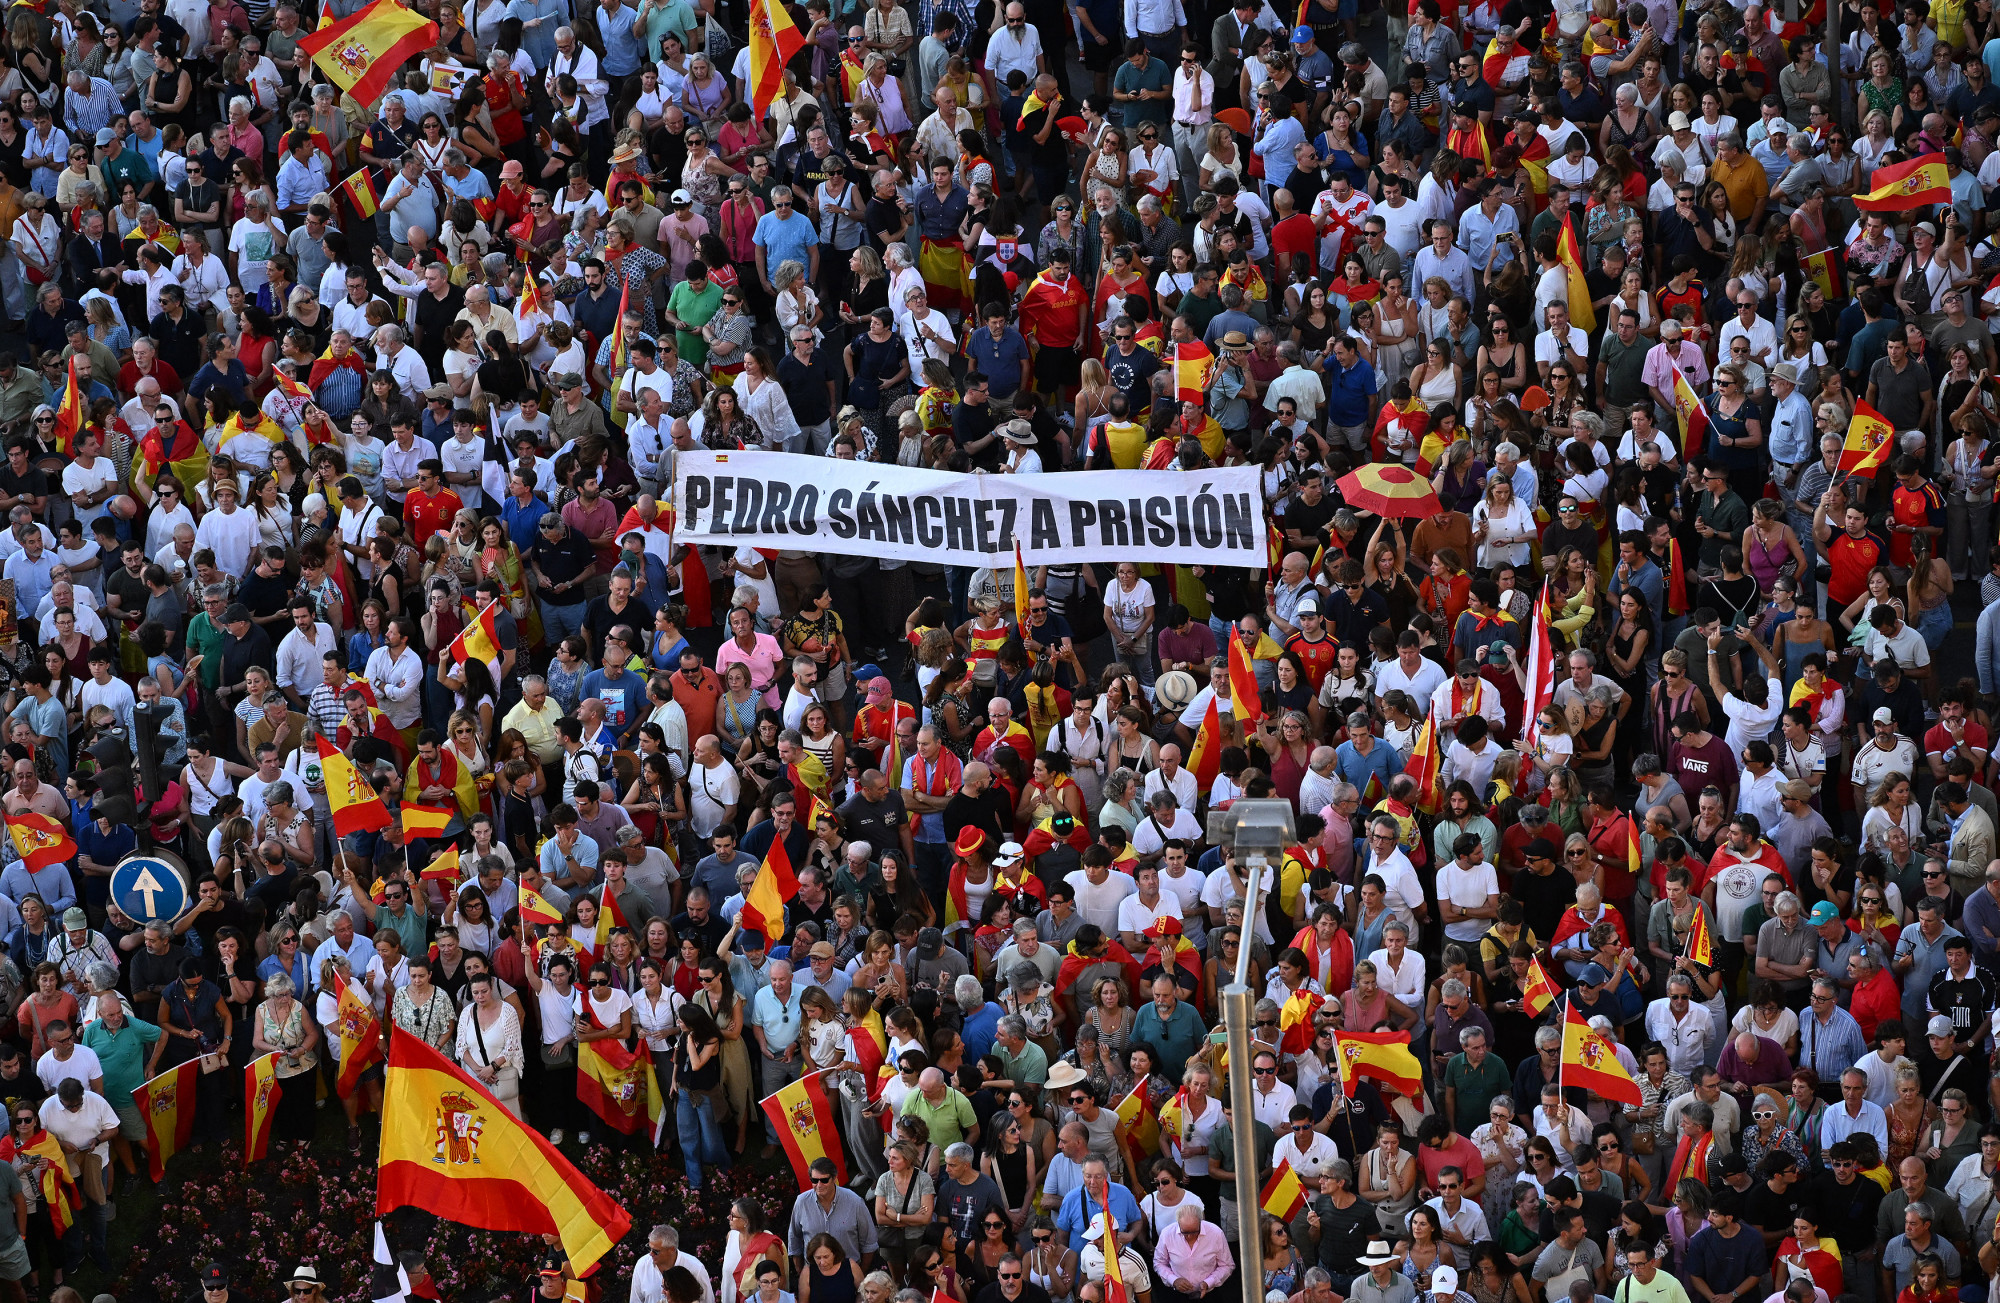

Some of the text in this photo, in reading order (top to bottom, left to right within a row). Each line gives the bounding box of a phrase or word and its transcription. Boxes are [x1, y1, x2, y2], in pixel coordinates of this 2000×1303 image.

[377, 130, 384, 142] 1
[1111, 362, 1134, 377] HOLLISTER
[413, 505, 421, 519] 5
[685, 475, 1254, 554] PEDRO SÁNCHEZ A PRISIÓN
[1309, 665, 1316, 678] 7
[1682, 757, 1709, 774] VANS
[1950, 1006, 1971, 1028] EUTA
